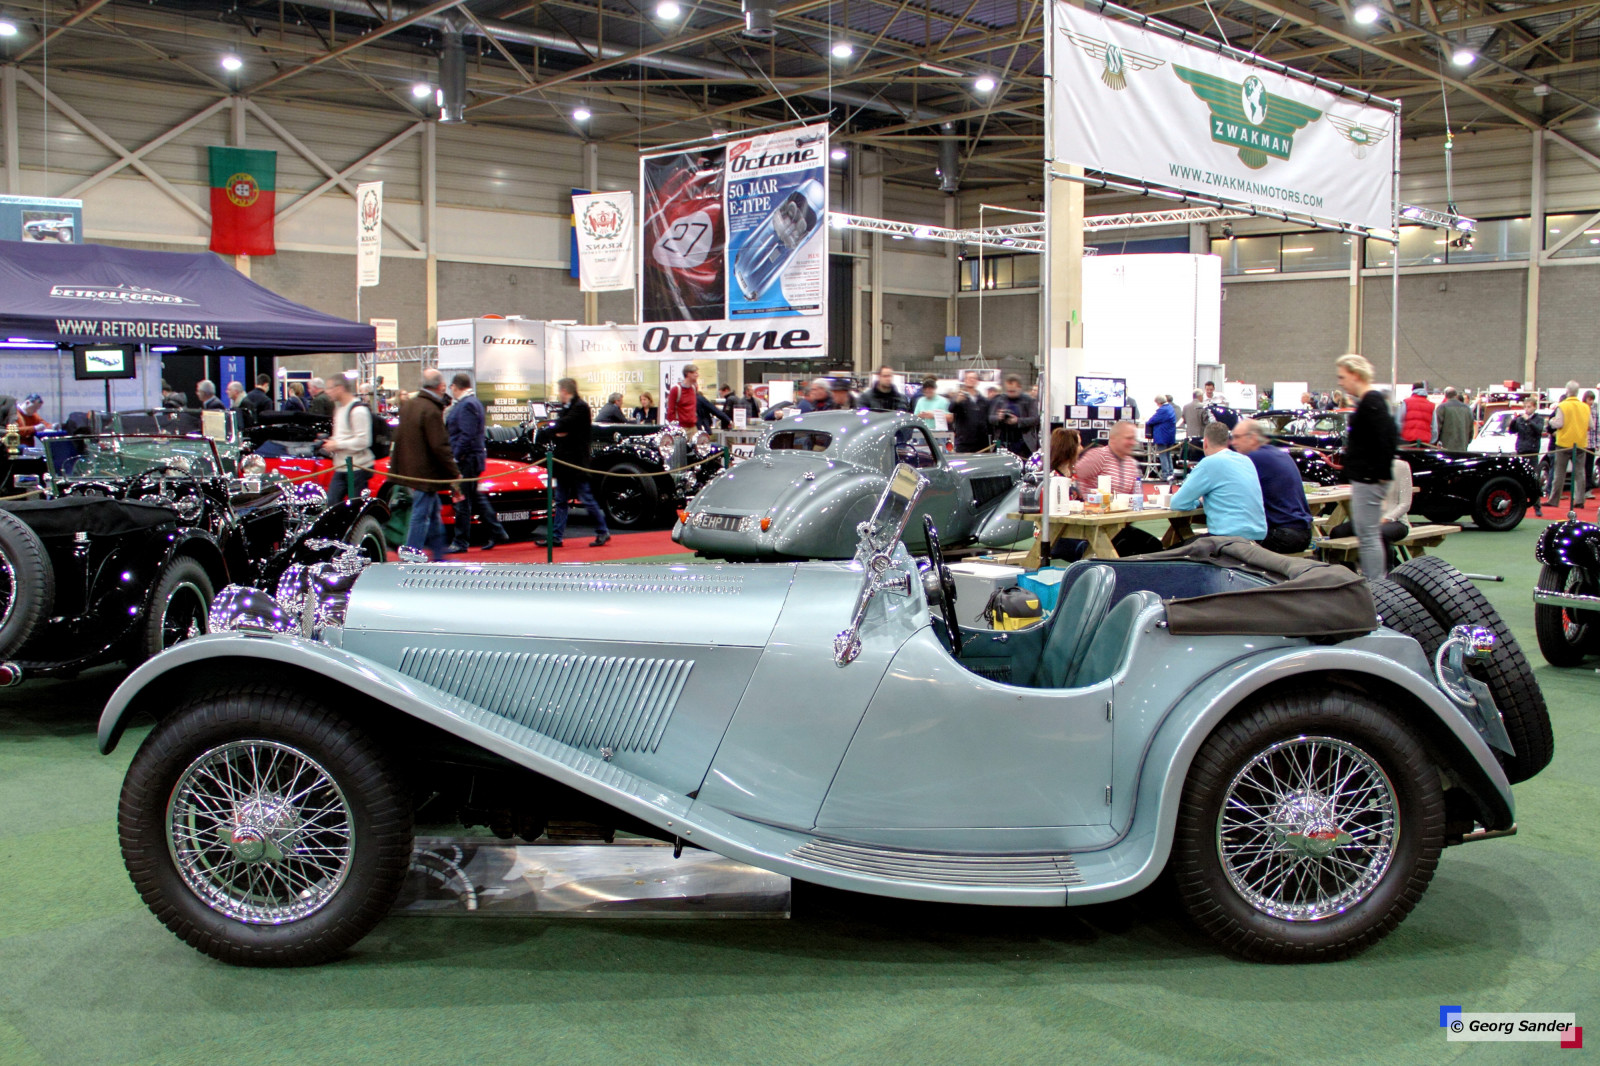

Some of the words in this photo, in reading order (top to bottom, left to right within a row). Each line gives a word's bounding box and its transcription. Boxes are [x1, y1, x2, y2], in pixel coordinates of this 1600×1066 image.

[1214, 119, 1291, 155] ZWAKMAN
[731, 148, 819, 173] Octane
[729, 183, 744, 199] 50
[747, 178, 778, 197] JAAR
[1168, 162, 1324, 209] WWW.ZWAKMANMOTORS.COM
[729, 196, 772, 216] E-TYPE
[662, 222, 709, 257] 27
[50, 288, 184, 304] RETROLEGENDS
[55, 318, 222, 342] WWW.RETROLEGENDS.NL
[482, 335, 538, 345] Octane
[642, 325, 823, 353] Octane
[440, 336, 471, 346] Octane
[587, 370, 644, 383] AUTOREIZEN
[601, 383, 626, 395] VOOR
[702, 514, 722, 528] EHP
